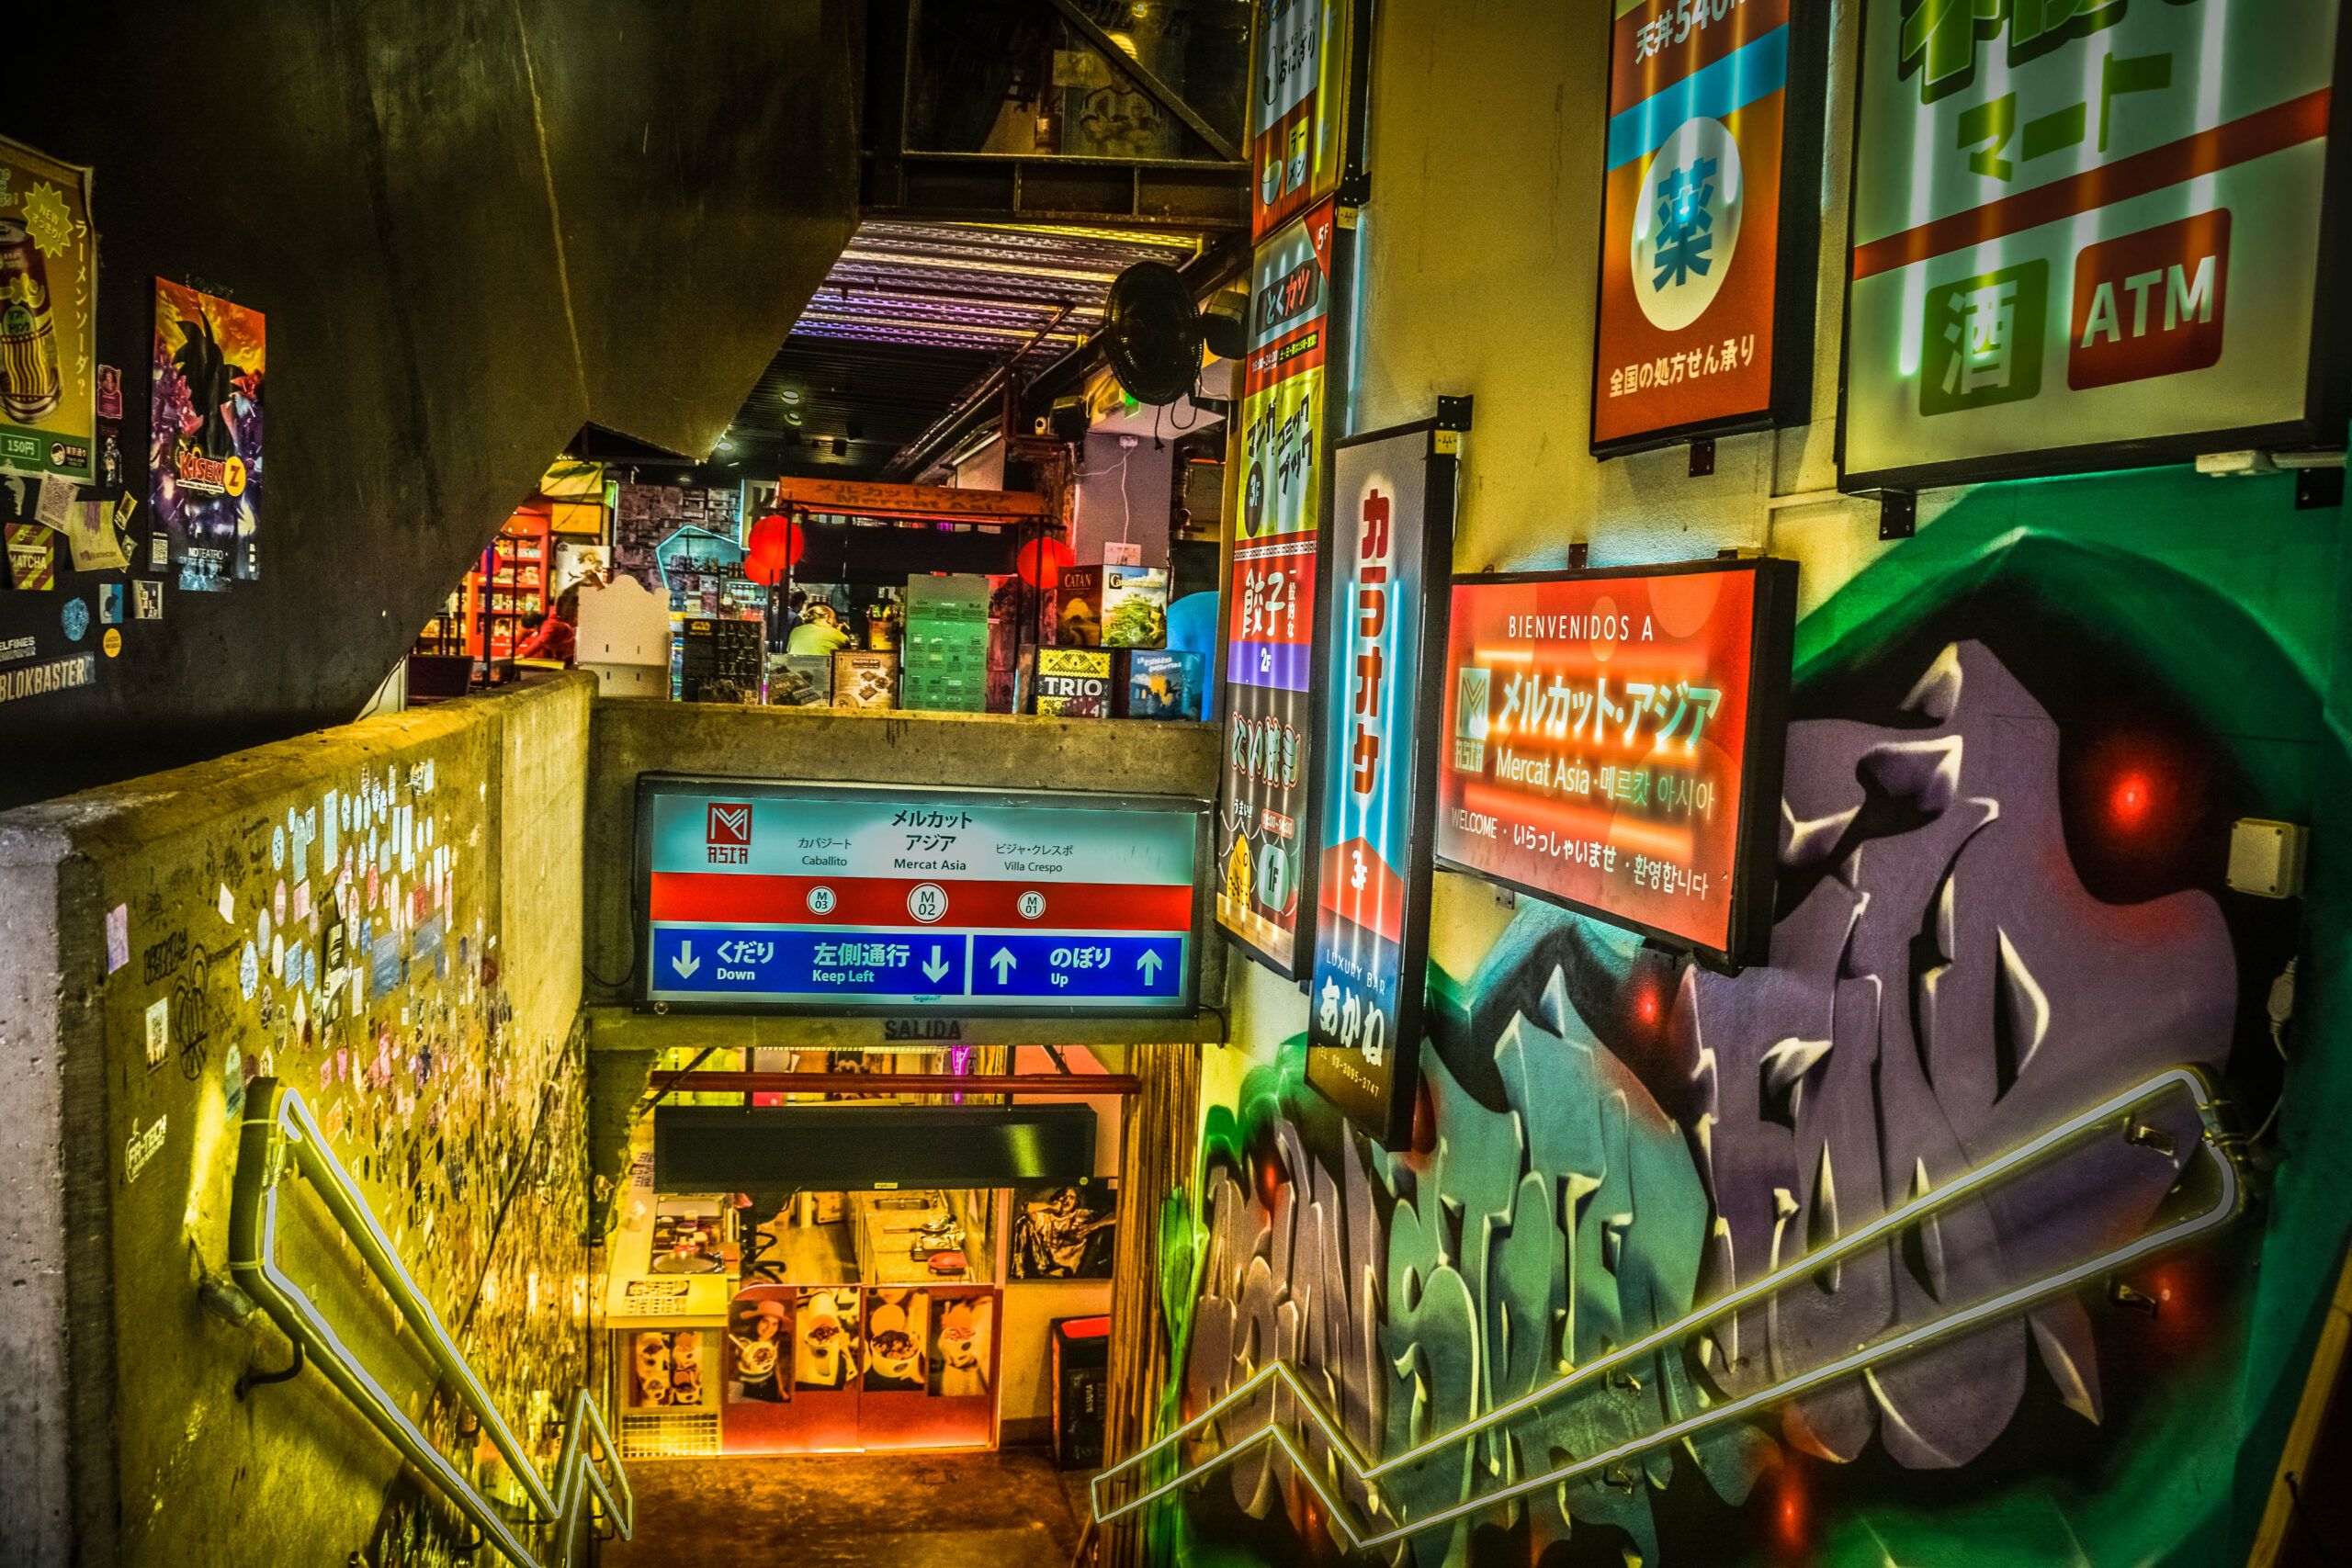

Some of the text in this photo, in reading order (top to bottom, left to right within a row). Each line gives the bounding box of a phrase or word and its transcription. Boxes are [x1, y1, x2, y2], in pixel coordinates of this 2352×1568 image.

[1957, 52, 2173, 183] マート
[40, 204, 60, 226] NEW
[1652, 157, 1717, 293] 薬
[1317, 222, 1329, 251] 5F
[2080, 255, 2216, 349] ATM
[1941, 280, 2018, 396] 酒
[1610, 334, 1755, 398] 全国の処方せん承り
[7, 439, 35, 456] 150円
[179, 452, 226, 486] KISEKI
[229, 465, 241, 488] Z
[1249, 473, 1261, 508] 3F
[1064, 573, 1091, 588] CATAN
[1242, 568, 1286, 639] 餃子
[1509, 615, 1654, 641] BIENVENIDOS A
[1353, 488, 1390, 795] カラオケ
[1260, 647, 1272, 672] 2F
[0, 658, 85, 704] BLOKBASTER
[1044, 677, 1102, 697] TRIO
[1498, 671, 1723, 750] メルカット・アジア
[1455, 739, 1484, 773] ASIA
[1496, 747, 1589, 795] Mercat Asia
[1657, 774, 1714, 820] 아시아
[891, 809, 973, 829] メルカット
[1451, 807, 1498, 840] WELCOME
[707, 846, 749, 864] ASIA
[797, 837, 852, 851] カバジート
[905, 833, 956, 852] アジア
[996, 842, 1073, 857] ビジャ・クレスポ
[1513, 823, 1617, 873] いらっしゃいませ
[802, 854, 848, 866] Caballito
[894, 858, 967, 871] Mercat Asia
[1004, 861, 1063, 874] Villa Crespo
[1351, 849, 1368, 891] 3F
[1268, 854, 1279, 893] 1F
[1634, 853, 1709, 900] 환영합니다
[814, 900, 829, 910] 03
[816, 891, 827, 901] M
[921, 891, 934, 903] M
[1027, 897, 1037, 906] M
[918, 903, 935, 916] 02
[1025, 905, 1037, 914] 01
[717, 940, 775, 964] くだり
[813, 942, 910, 967] 左側通行
[1050, 946, 1112, 969] のぼり
[717, 967, 755, 981] Down
[812, 969, 875, 985] Keep Left
[1051, 973, 1069, 988] Up
[1326, 948, 1386, 996] LUXURY BAR
[885, 1020, 962, 1040] SALIDA
[1319, 975, 1385, 1067] あかね
